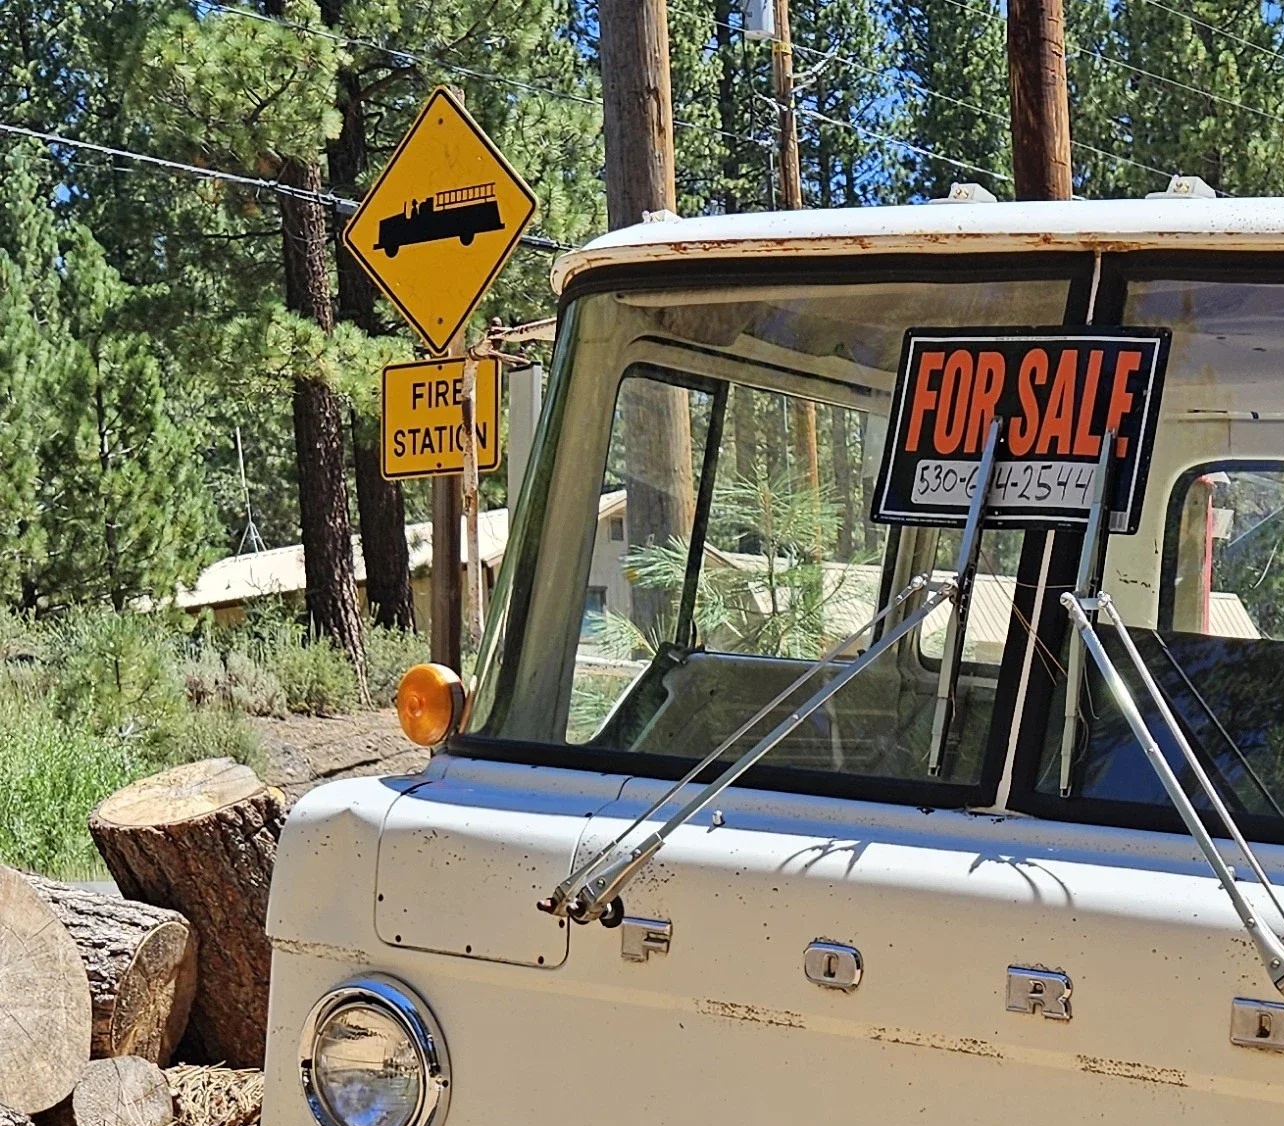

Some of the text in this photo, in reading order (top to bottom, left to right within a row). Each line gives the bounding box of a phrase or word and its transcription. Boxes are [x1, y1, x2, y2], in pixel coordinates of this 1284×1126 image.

[412, 379, 463, 410] FIRE
[905, 349, 1141, 458] FOR SALE
[917, 464, 1094, 505] 530-64-2544
